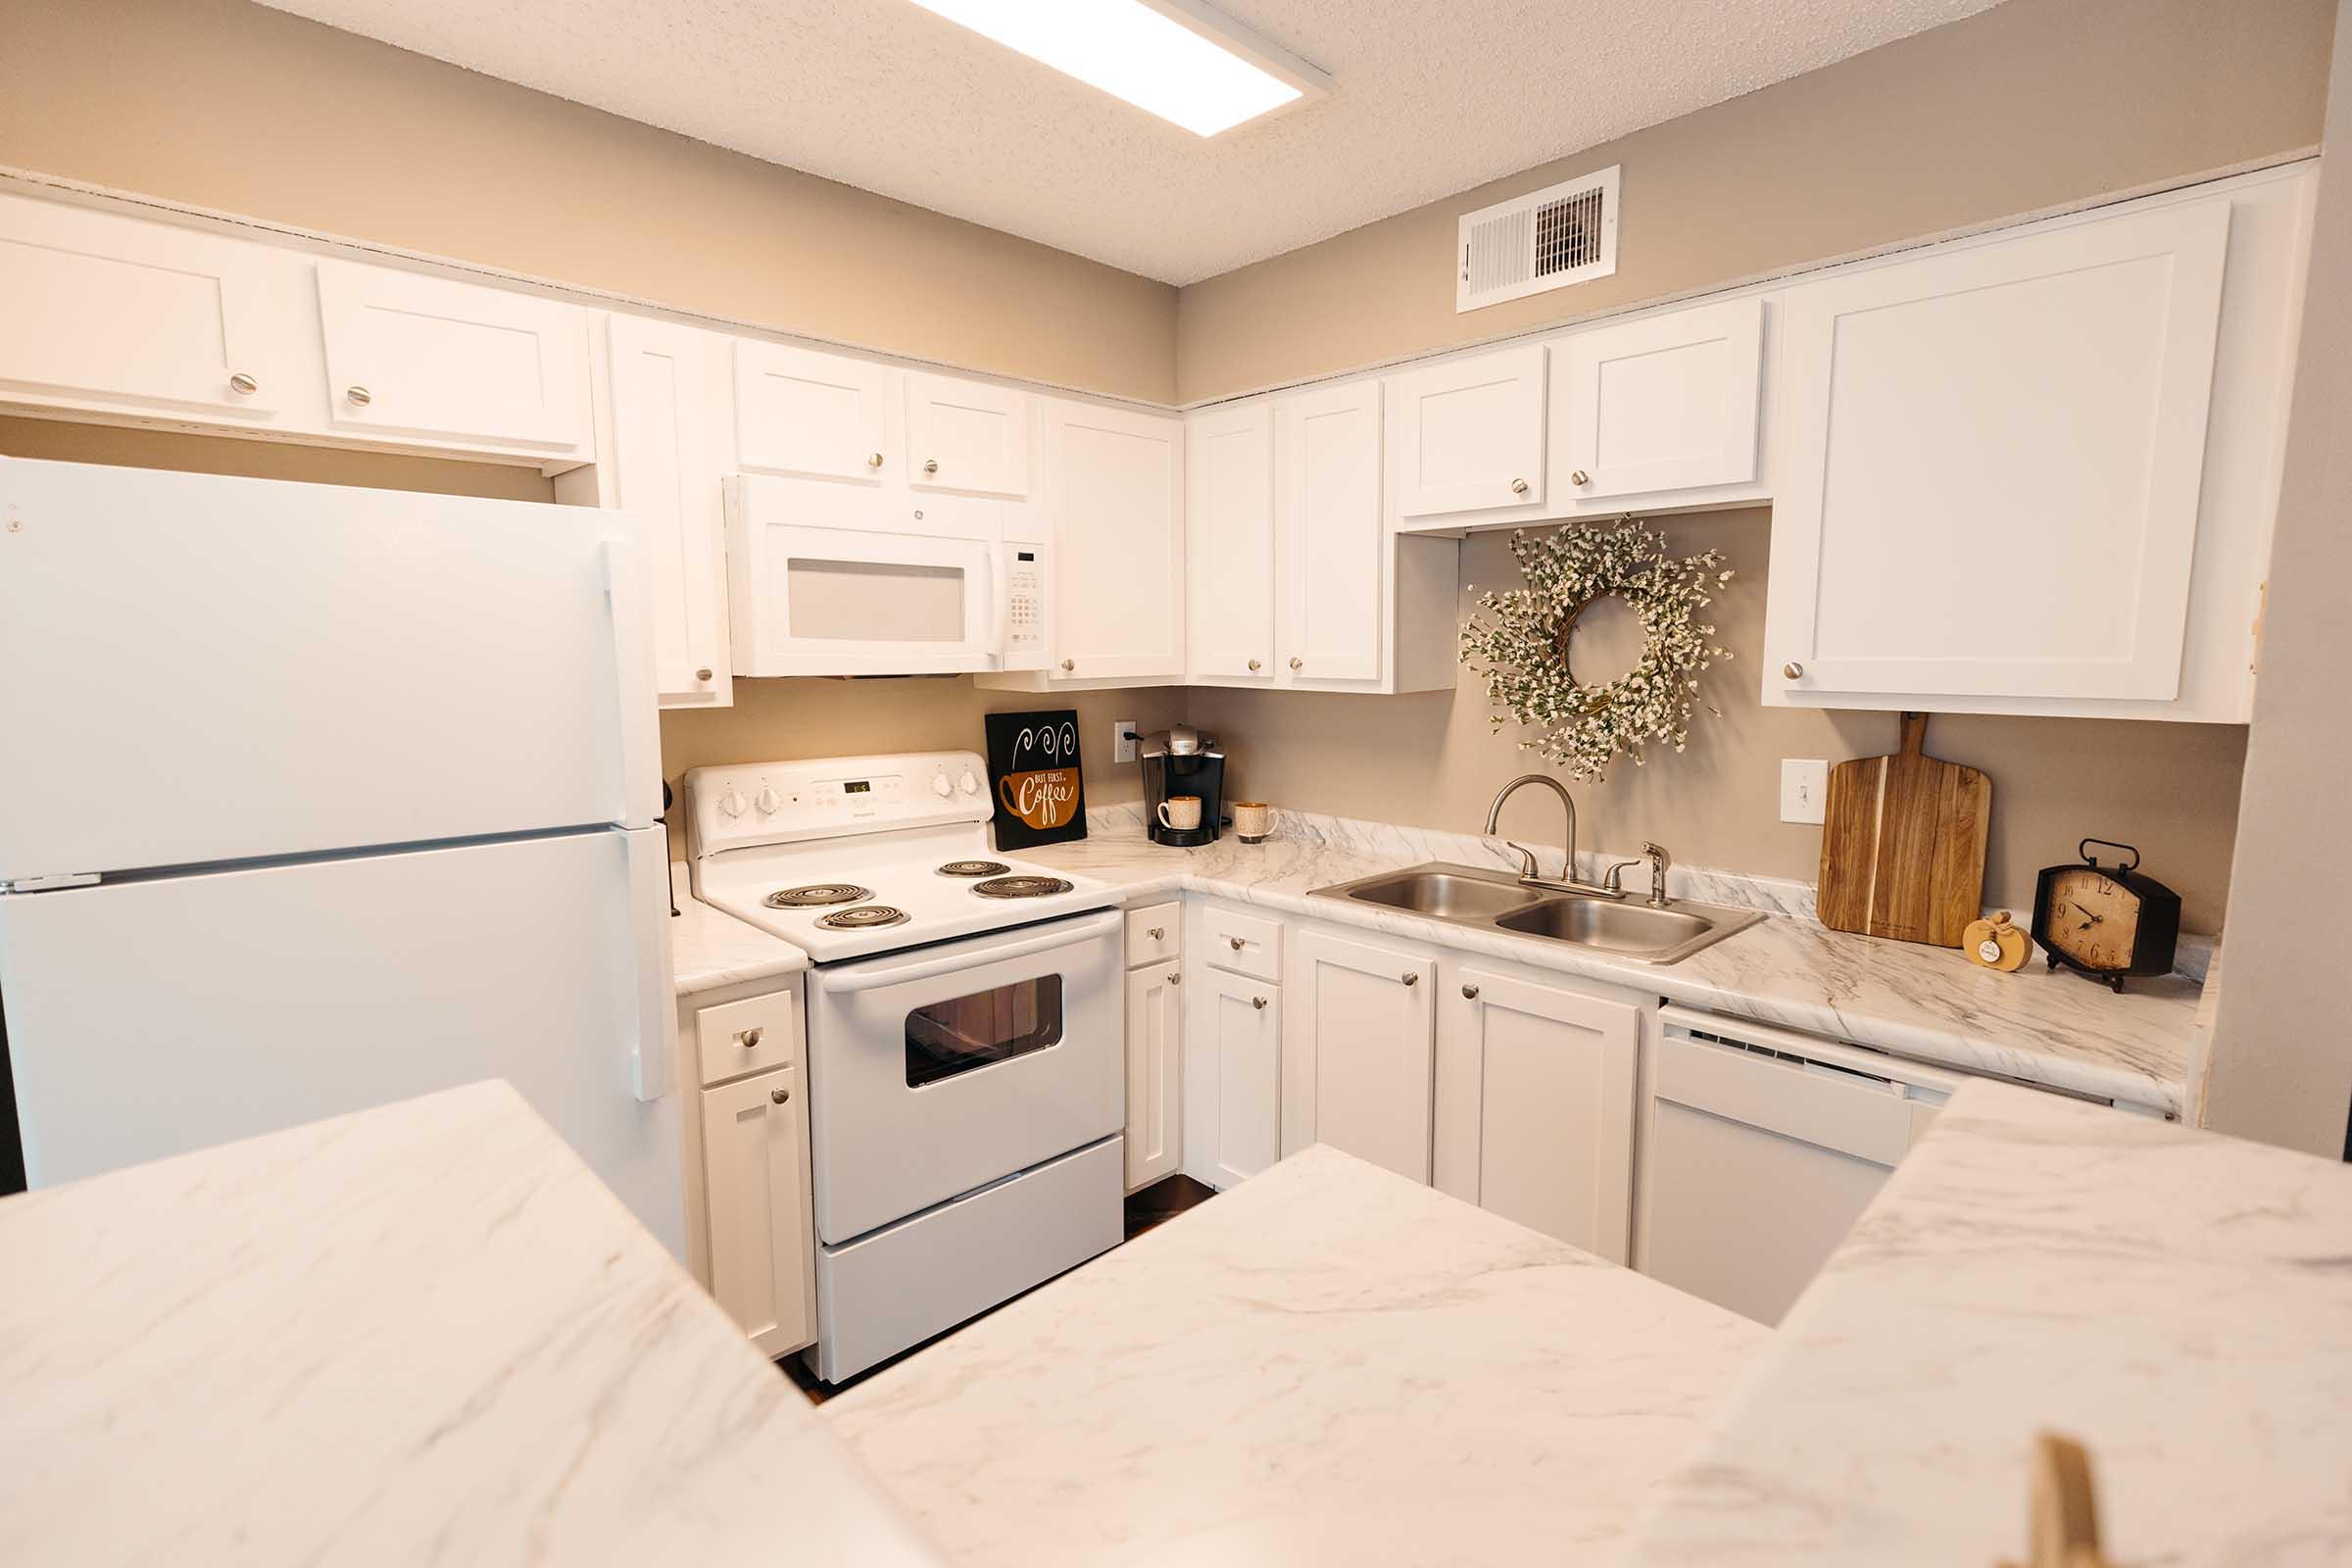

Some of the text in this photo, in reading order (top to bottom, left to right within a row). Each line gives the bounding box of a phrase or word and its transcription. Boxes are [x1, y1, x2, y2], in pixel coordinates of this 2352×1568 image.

[1034, 773, 1046, 784] BUT
[1019, 777, 1074, 826] Coffee
[2064, 885, 2074, 896] 10
[2098, 878, 2113, 895] 12
[2058, 903, 2066, 918] 9
[2063, 927, 2069, 939] 8
[2090, 943, 2100, 958] 6
